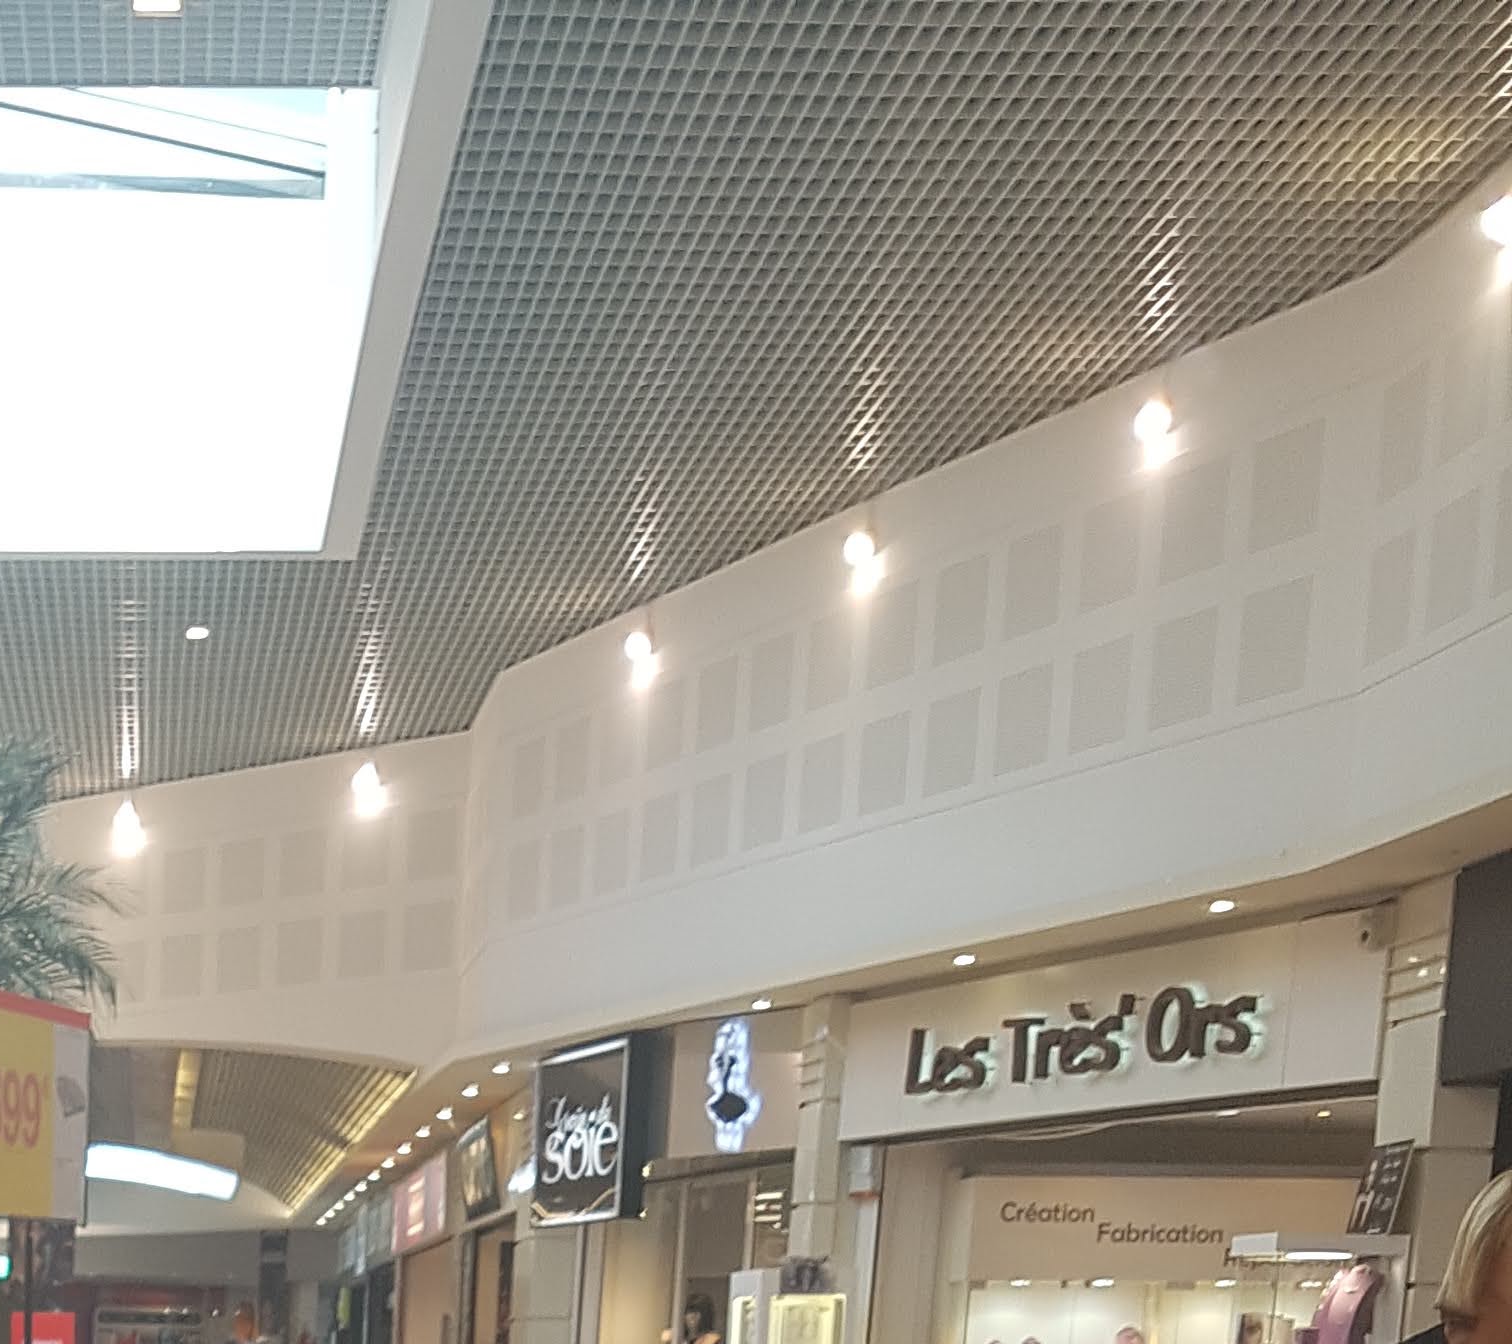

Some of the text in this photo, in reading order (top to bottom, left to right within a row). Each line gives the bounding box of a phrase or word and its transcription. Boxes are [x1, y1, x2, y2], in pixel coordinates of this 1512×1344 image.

[905, 1027, 991, 1095] Les
[1146, 986, 1259, 1063] Ors
[1000, 1201, 1096, 1224] Création
[1096, 1222, 1225, 1245] Fabrication
